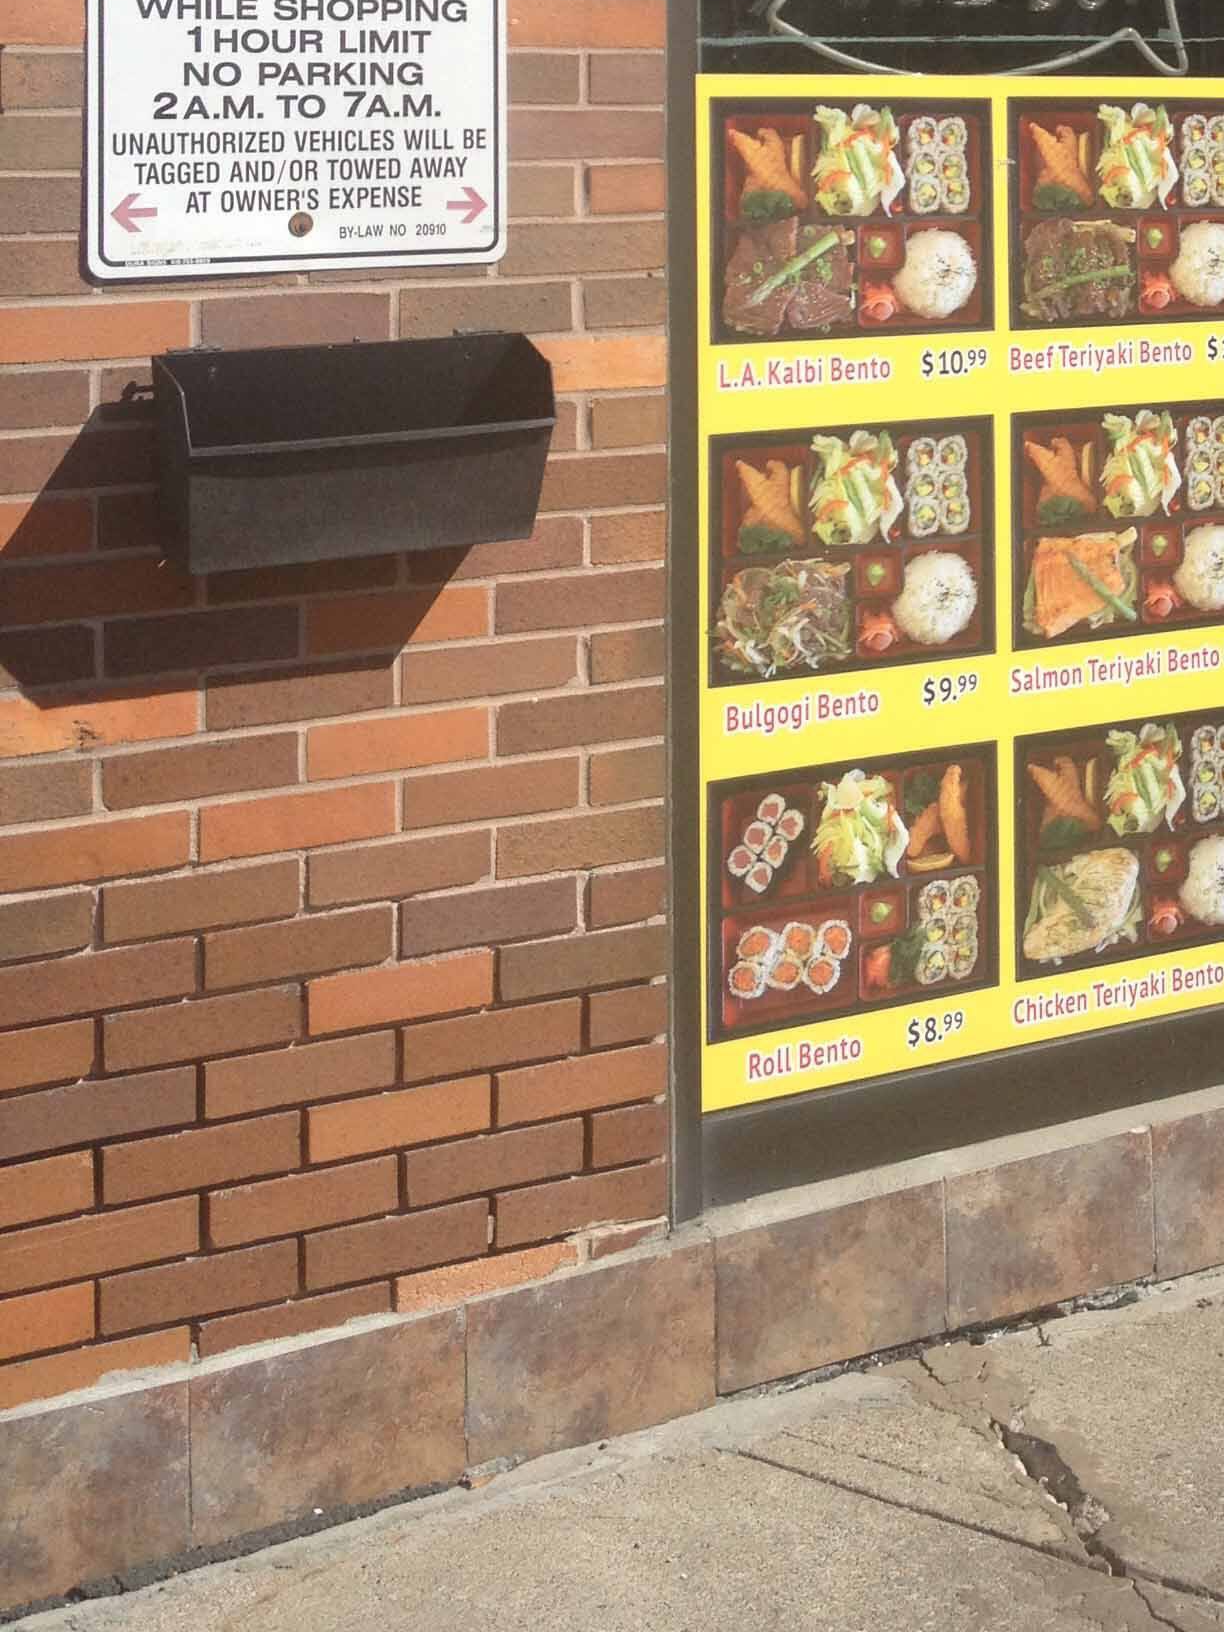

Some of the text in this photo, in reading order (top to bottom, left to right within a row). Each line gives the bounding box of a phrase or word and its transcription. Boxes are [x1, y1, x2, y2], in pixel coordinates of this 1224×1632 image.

[213, 28, 325, 55] HOUR
[339, 29, 432, 56] LIMIT
[183, 61, 425, 88] NO PARKING
[276, 94, 327, 119] TO
[112, 128, 487, 156] UNAUTHORIZED VEHICLES WILL BE
[134, 156, 468, 185] TAGGED AND/OR TOWED AWAY
[185, 186, 423, 214] AT OWNER'S EXPENSE
[339, 223, 447, 239] BY-LAW NO 20910
[1009, 340, 1193, 372] Beef Teriyaki Bento
[718, 355, 891, 390] L.A. Kalbi Bento
[1010, 647, 1221, 694] Salmon Teriyaki Bento
[922, 673, 978, 705] $9.99
[725, 691, 880, 733] Bulgogi Bento
[1012, 993, 1089, 1026] Chicken
[1092, 972, 1167, 1009] Teriyaki
[906, 1011, 965, 1048] $8.99
[747, 1037, 862, 1081] Roll Bento
